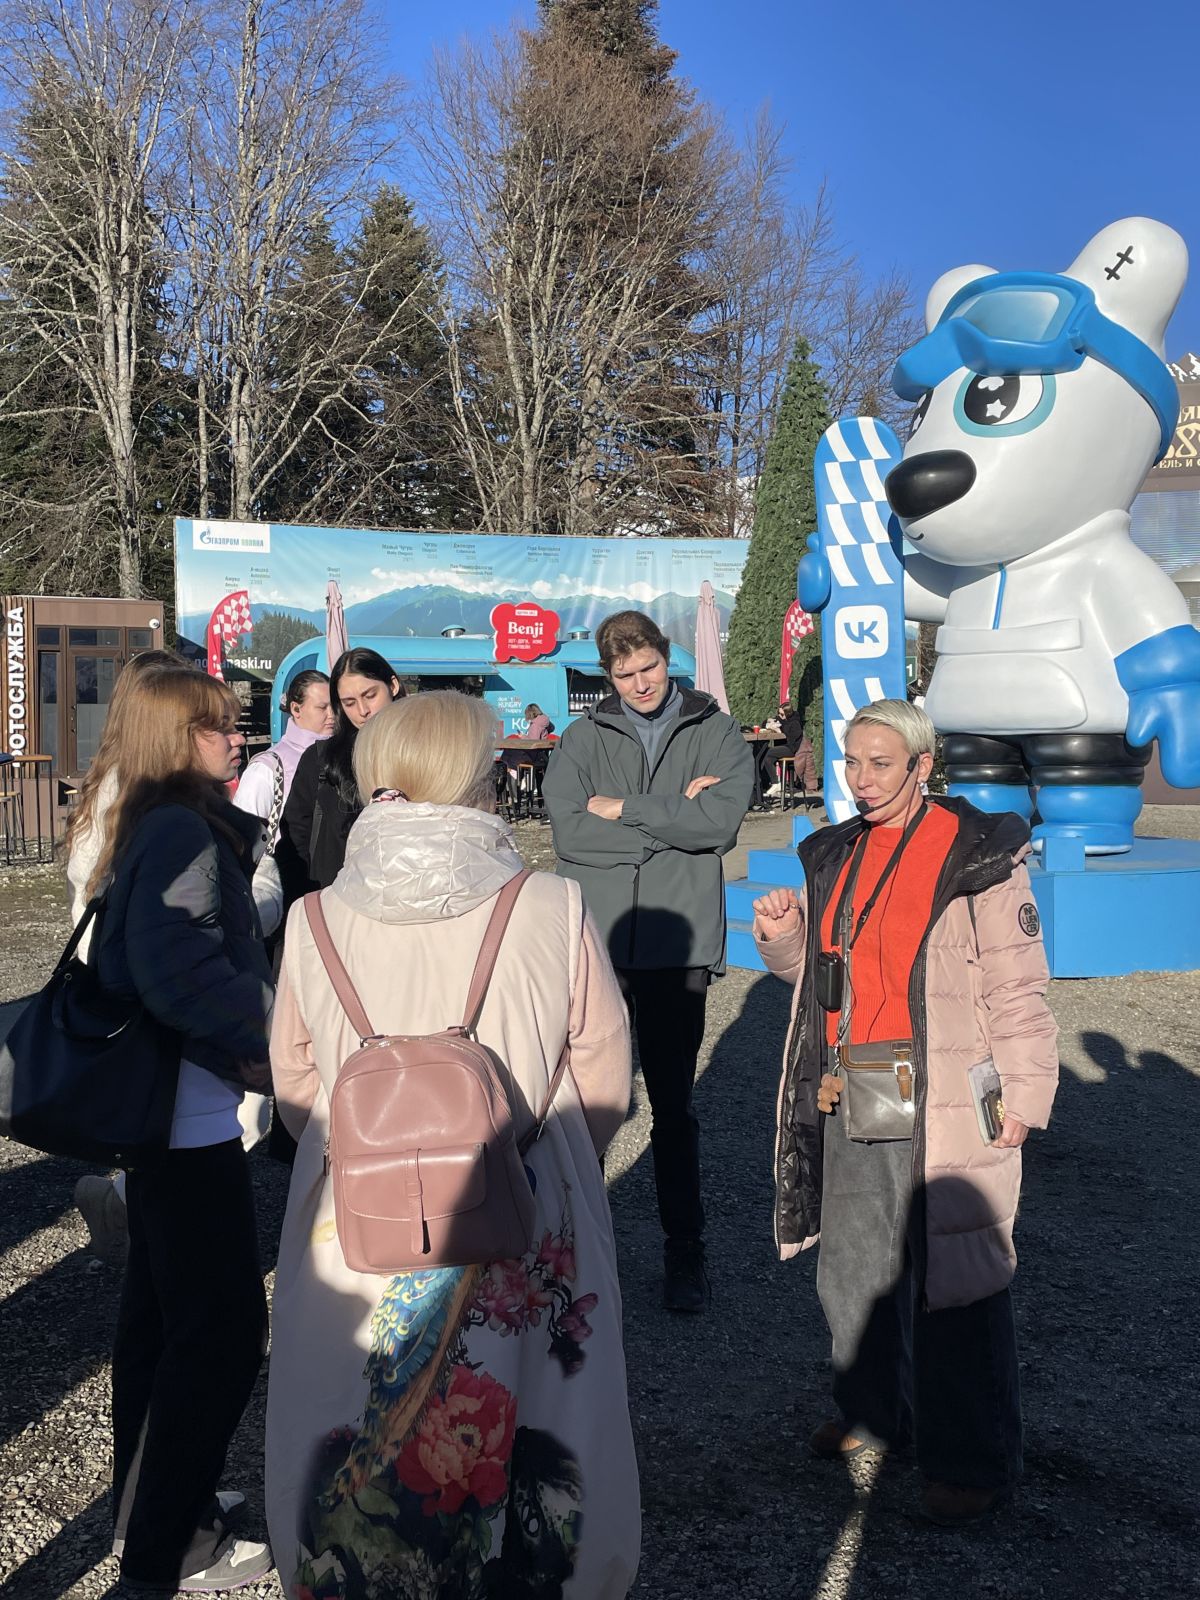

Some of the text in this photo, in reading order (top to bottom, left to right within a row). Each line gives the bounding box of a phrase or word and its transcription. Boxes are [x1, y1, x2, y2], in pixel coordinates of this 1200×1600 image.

[1153, 459, 1182, 469] ЕЛЬ
[508, 622, 544, 638] Benji
[843, 621, 880, 643] VK
